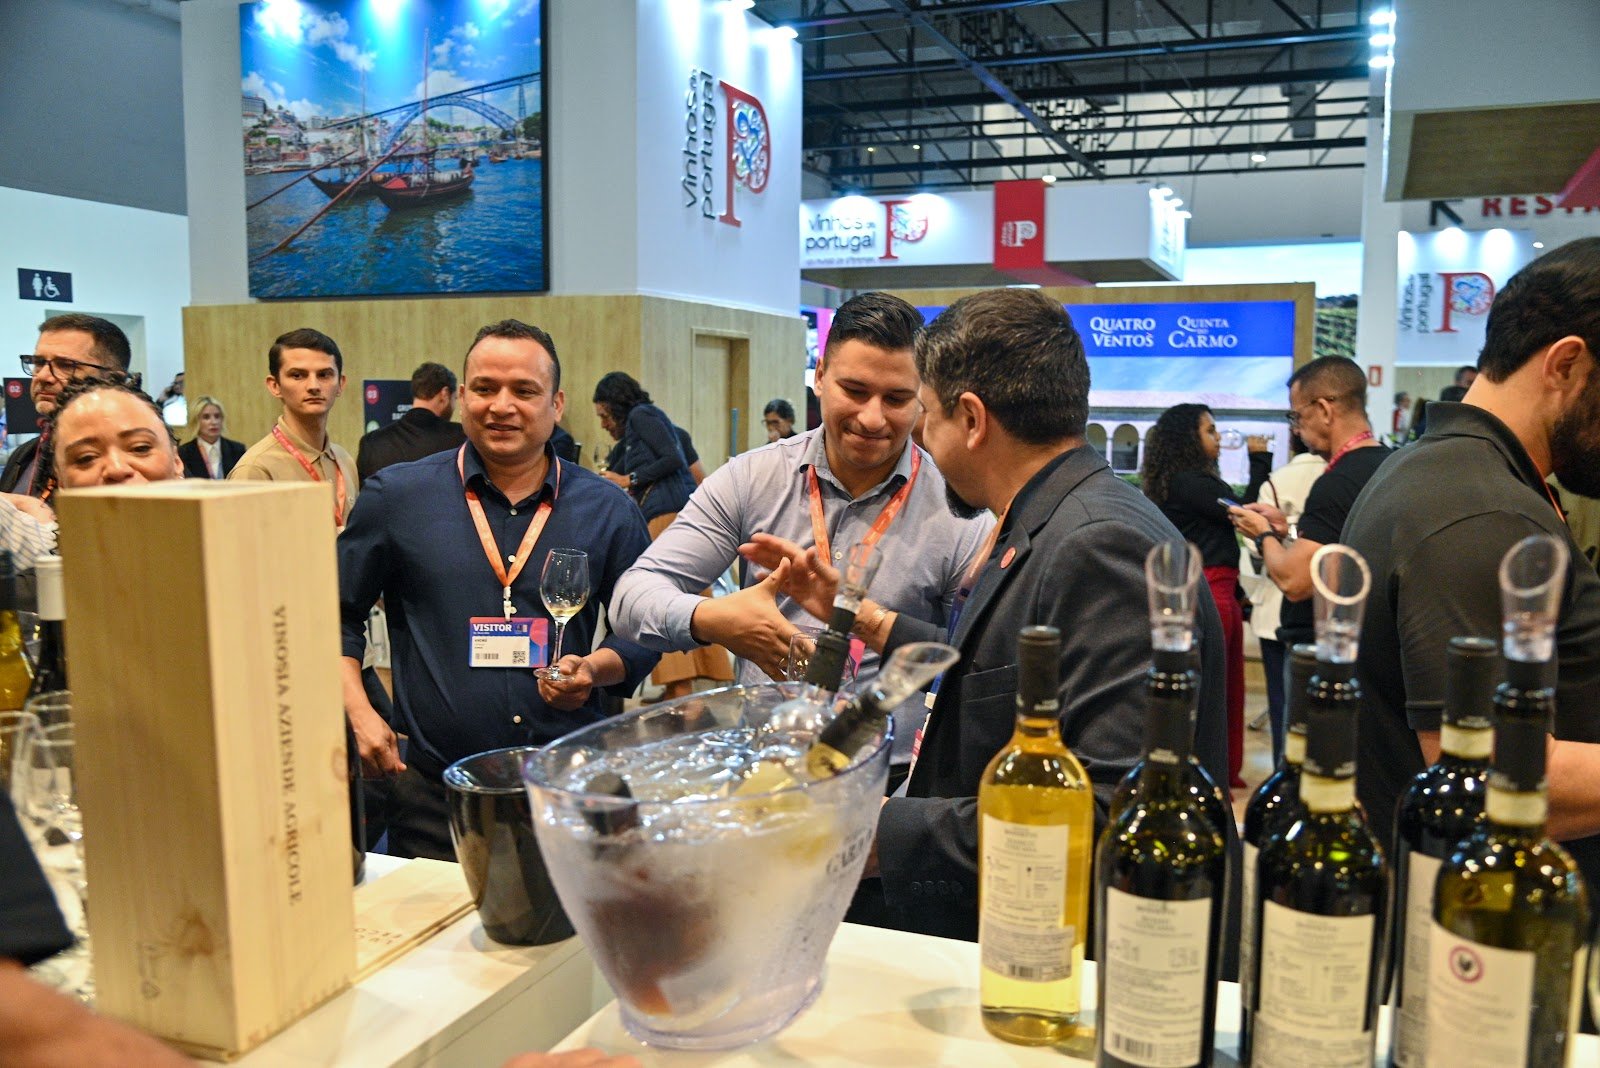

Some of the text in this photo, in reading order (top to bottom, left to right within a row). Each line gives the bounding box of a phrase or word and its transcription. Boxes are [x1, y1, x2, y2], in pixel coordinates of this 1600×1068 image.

[700, 70, 716, 219] portugal
[1482, 194, 1600, 217] RES
[806, 231, 876, 254] portugal
[1089, 316, 1156, 334] QUATRO
[1177, 315, 1229, 333] QUINTA
[1092, 333, 1154, 348] VENTOS
[1168, 330, 1239, 349] CARMO
[473, 623, 512, 632] VISITOR
[272, 604, 304, 906] VINOSIA AZIENDE AGRICOLE
